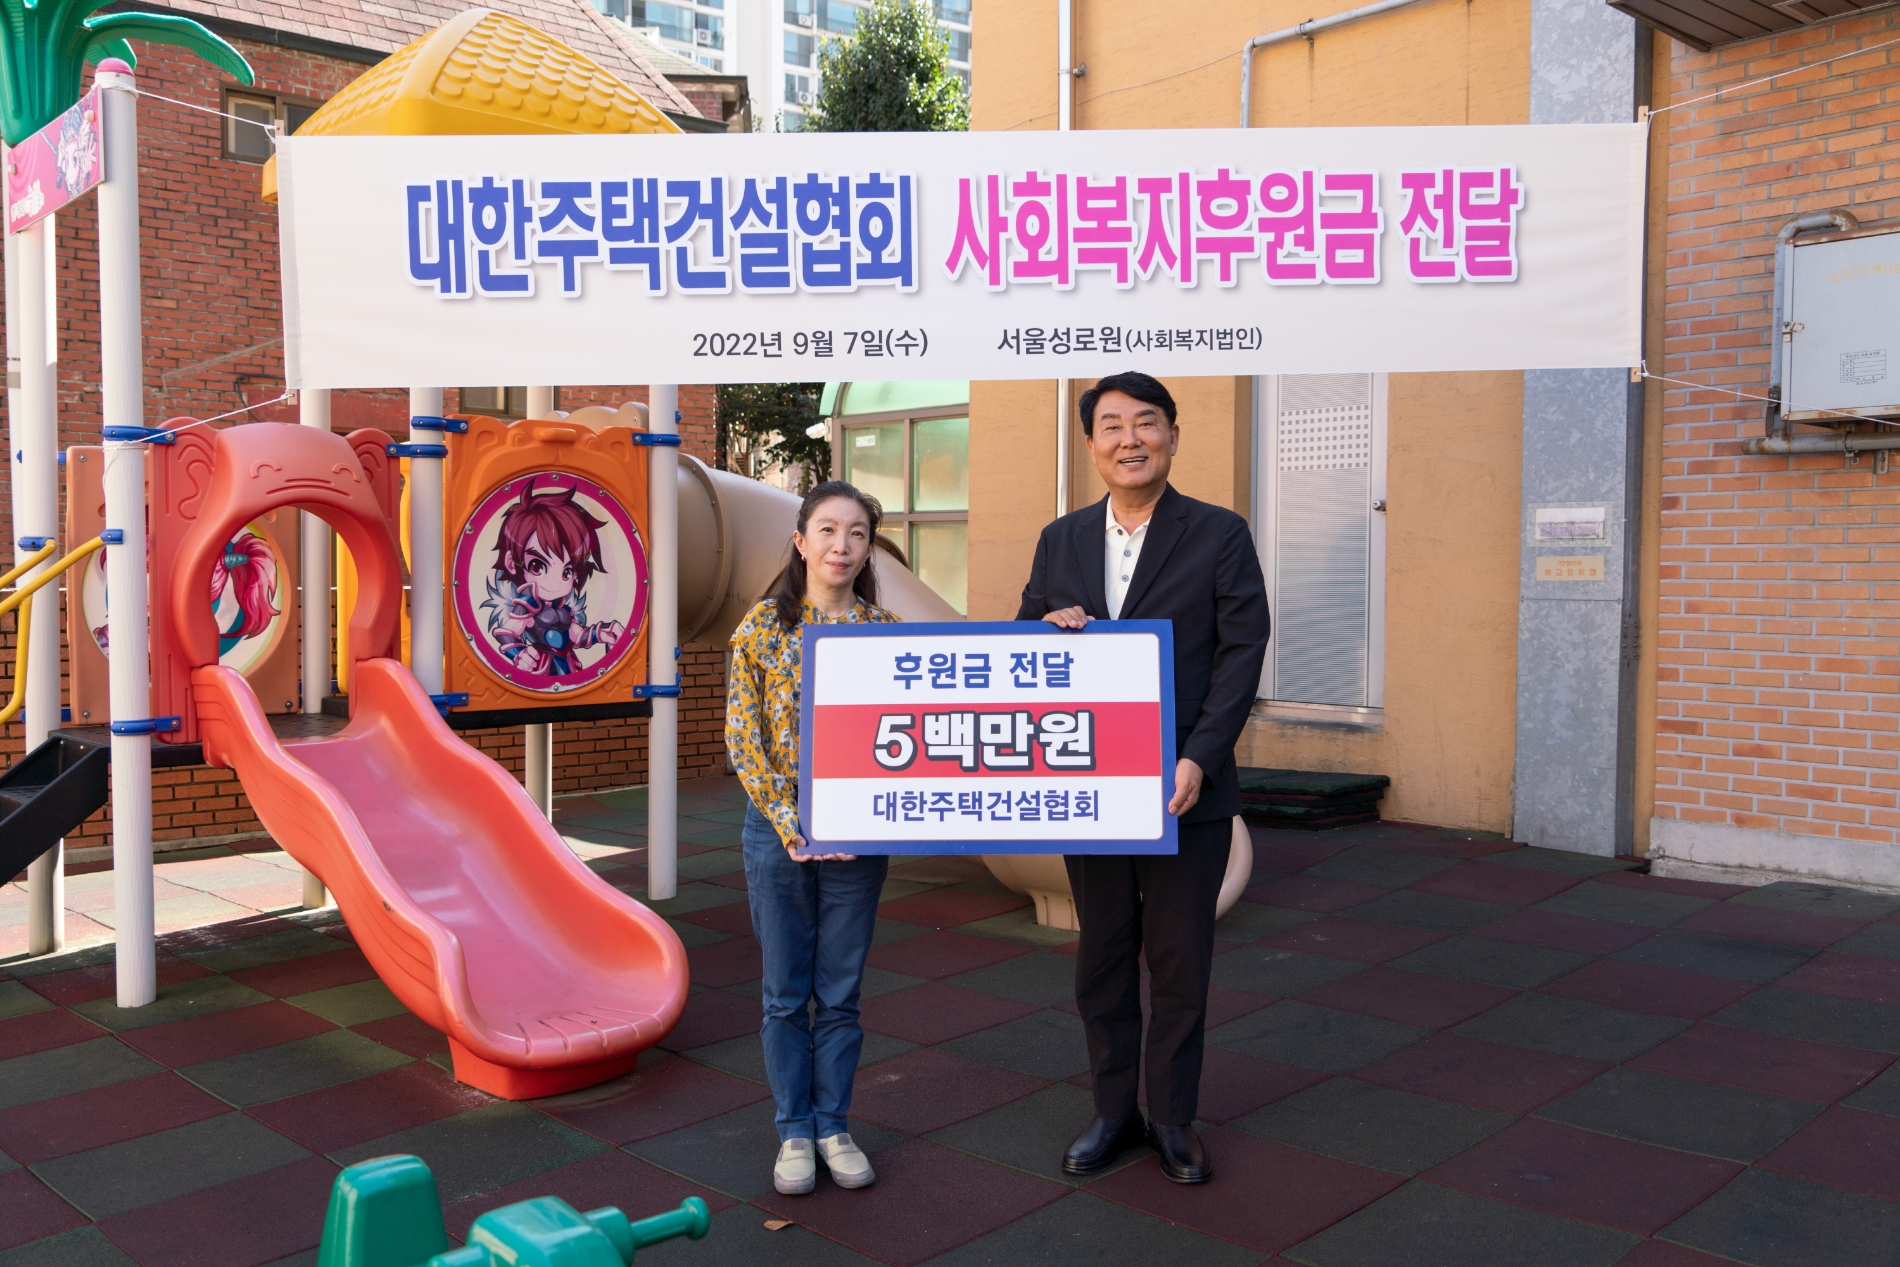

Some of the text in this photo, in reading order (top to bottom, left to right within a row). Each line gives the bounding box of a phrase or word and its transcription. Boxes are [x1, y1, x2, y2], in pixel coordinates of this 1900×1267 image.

[406, 168, 1519, 293] 대한주택건설협회 사회복지후원금 전달
[693, 328, 928, 358] 2022년 9월 7일(수)
[893, 651, 1075, 690] 후원금 전달
[873, 789, 1099, 823] 대한주택건설협회
